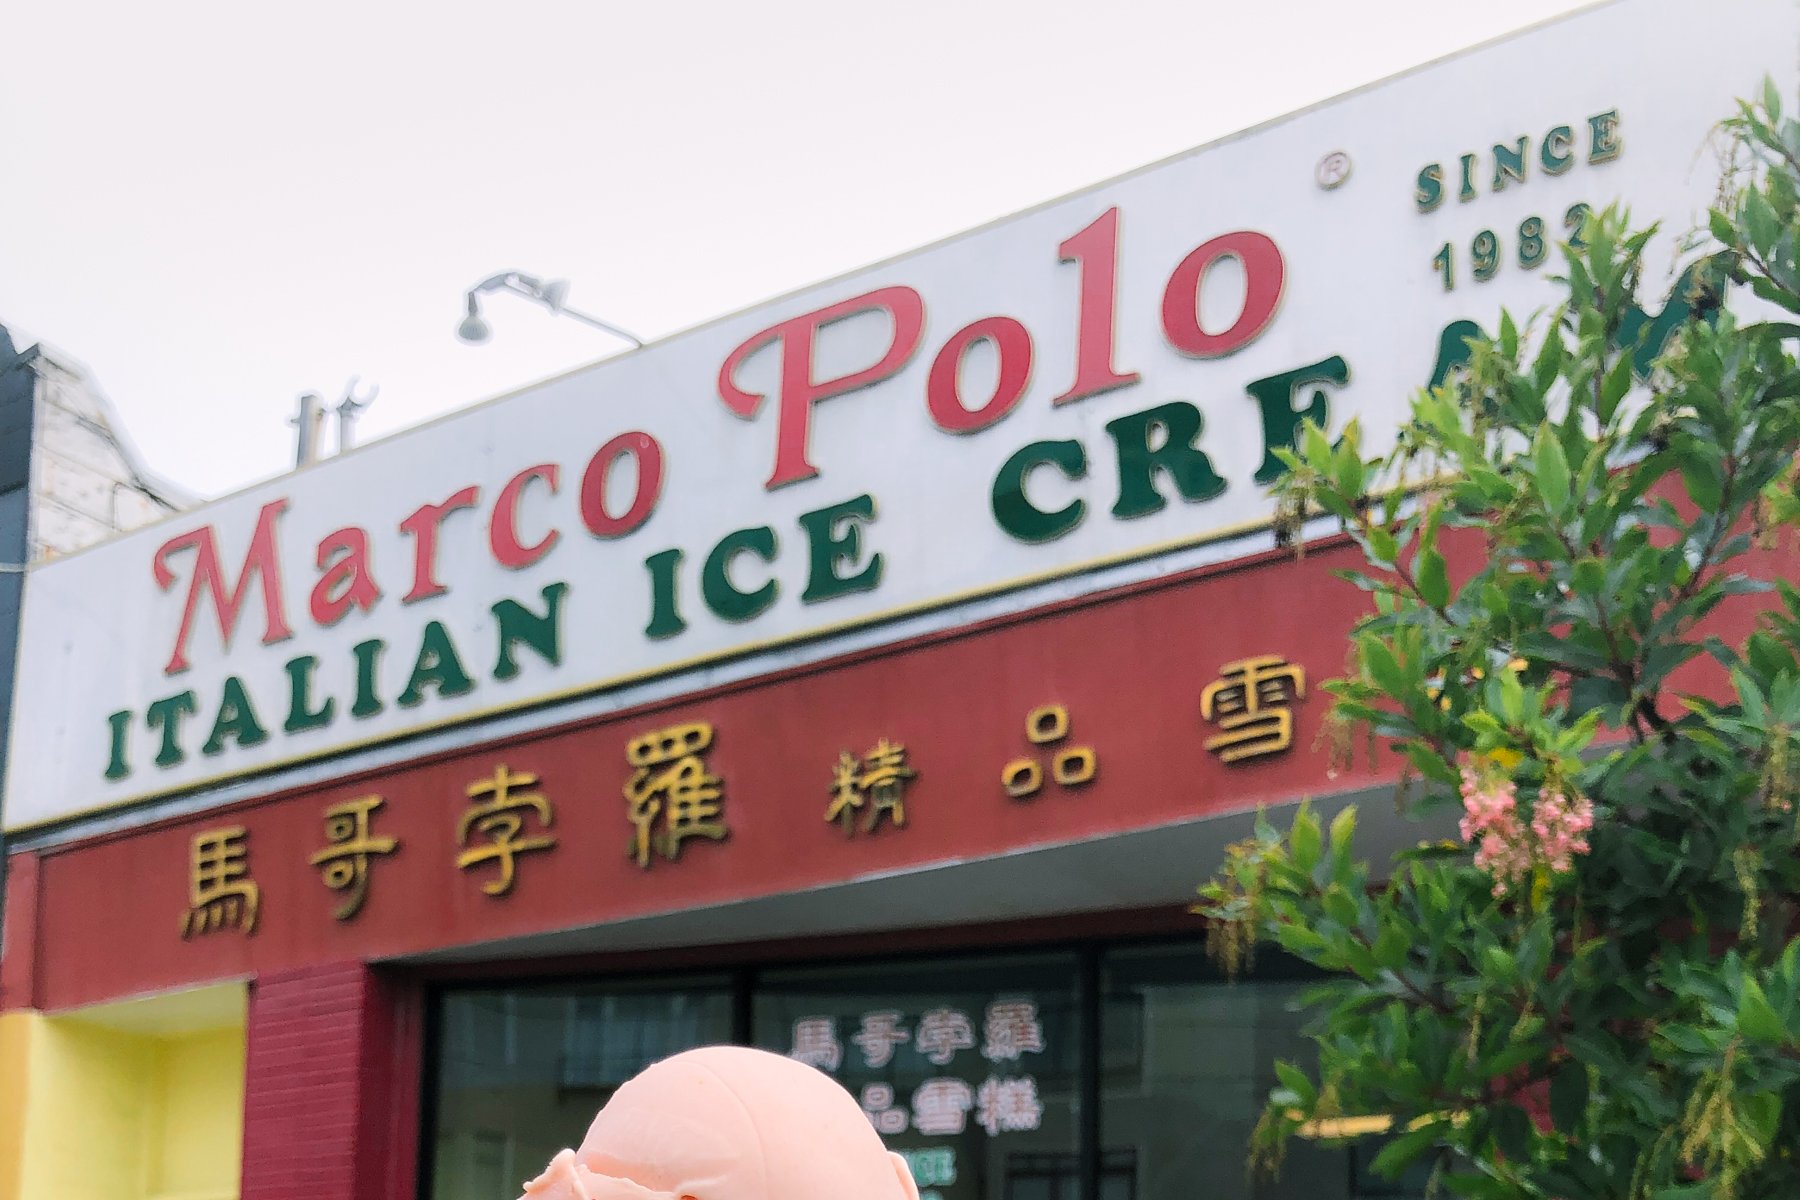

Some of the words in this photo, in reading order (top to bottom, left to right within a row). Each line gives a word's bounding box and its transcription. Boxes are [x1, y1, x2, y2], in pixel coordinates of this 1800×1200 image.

[1413, 109, 1621, 214] SINCE
[1431, 202, 1592, 292] 1982
[153, 430, 666, 676] Marco
[716, 205, 1287, 491] Polo
[104, 580, 569, 781] ITALIAN
[645, 492, 883, 642] ICE
[181, 653, 1530, 942] 馬哥孛羅精品雪
